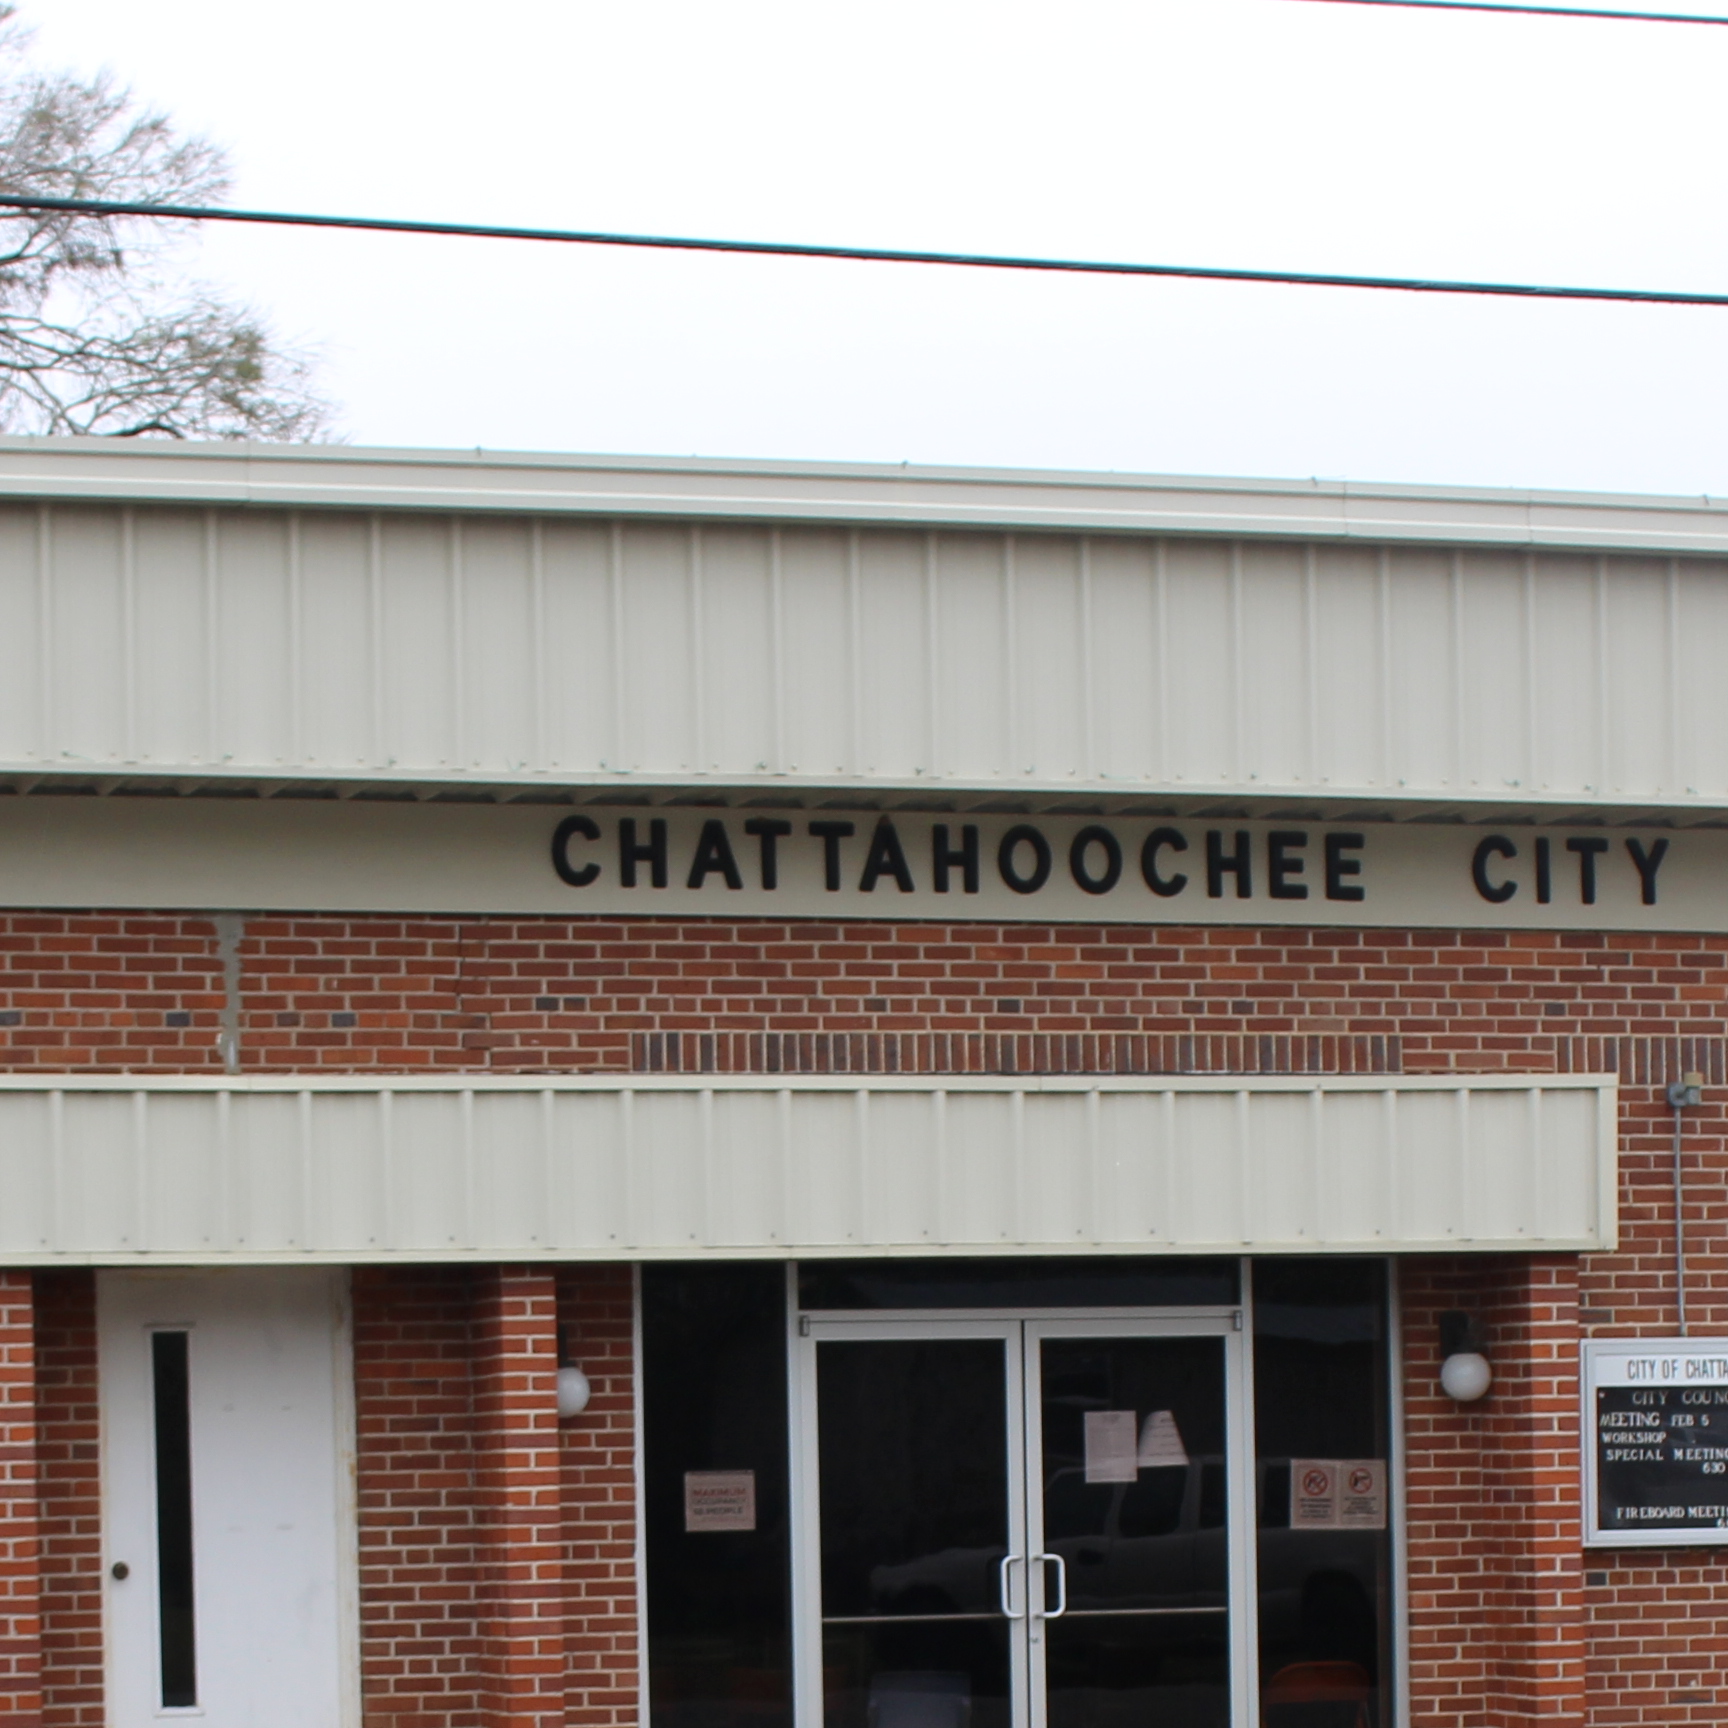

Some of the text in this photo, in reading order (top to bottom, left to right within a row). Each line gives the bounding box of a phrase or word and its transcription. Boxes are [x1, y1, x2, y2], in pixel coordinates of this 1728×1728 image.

[550, 814, 1366, 902] CHATTAHOOCHEE
[1471, 834, 1670, 906] CITY
[1627, 1359, 1656, 1379] CITY
[1662, 1359, 1678, 1379] OF
[1632, 1390, 1669, 1405] CITY
[1600, 1411, 1660, 1427] MEETING
[1671, 1413, 1694, 1428] FEB
[1602, 1431, 1667, 1444] WORKSHOP
[1606, 1448, 1664, 1461] SPECIAL
[1702, 1461, 1726, 1474] 630
